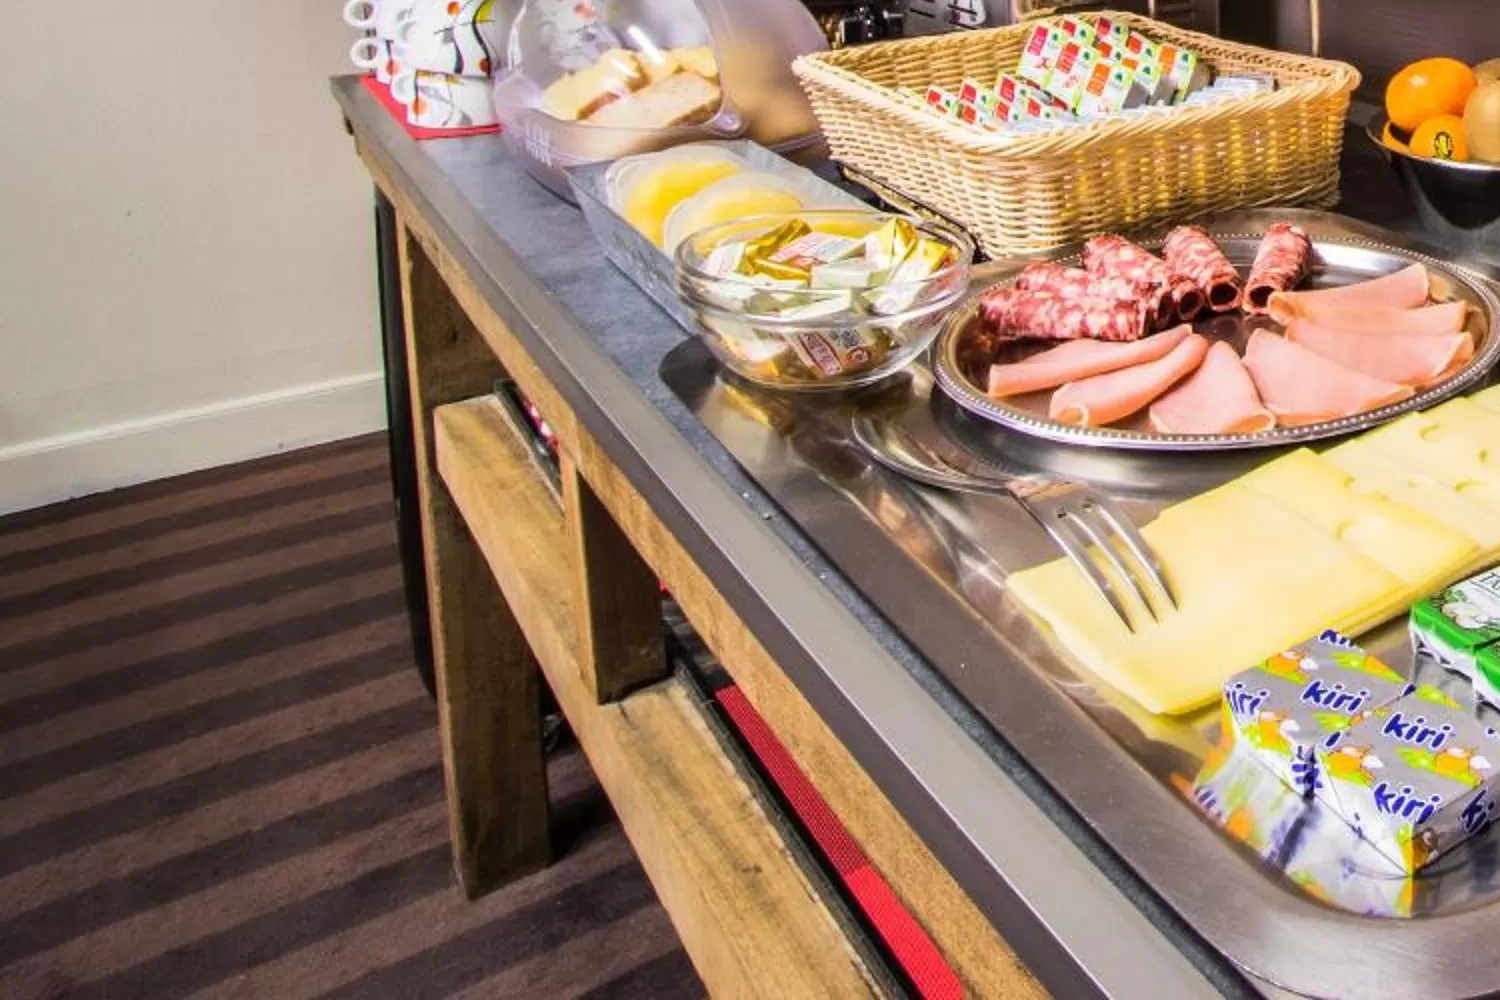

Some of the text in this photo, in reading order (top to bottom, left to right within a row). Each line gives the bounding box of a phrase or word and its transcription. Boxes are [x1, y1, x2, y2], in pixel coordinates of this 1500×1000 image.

[1301, 679, 1369, 713] kiri
[1383, 712, 1453, 749] kiri
[1373, 782, 1442, 826] kiri
